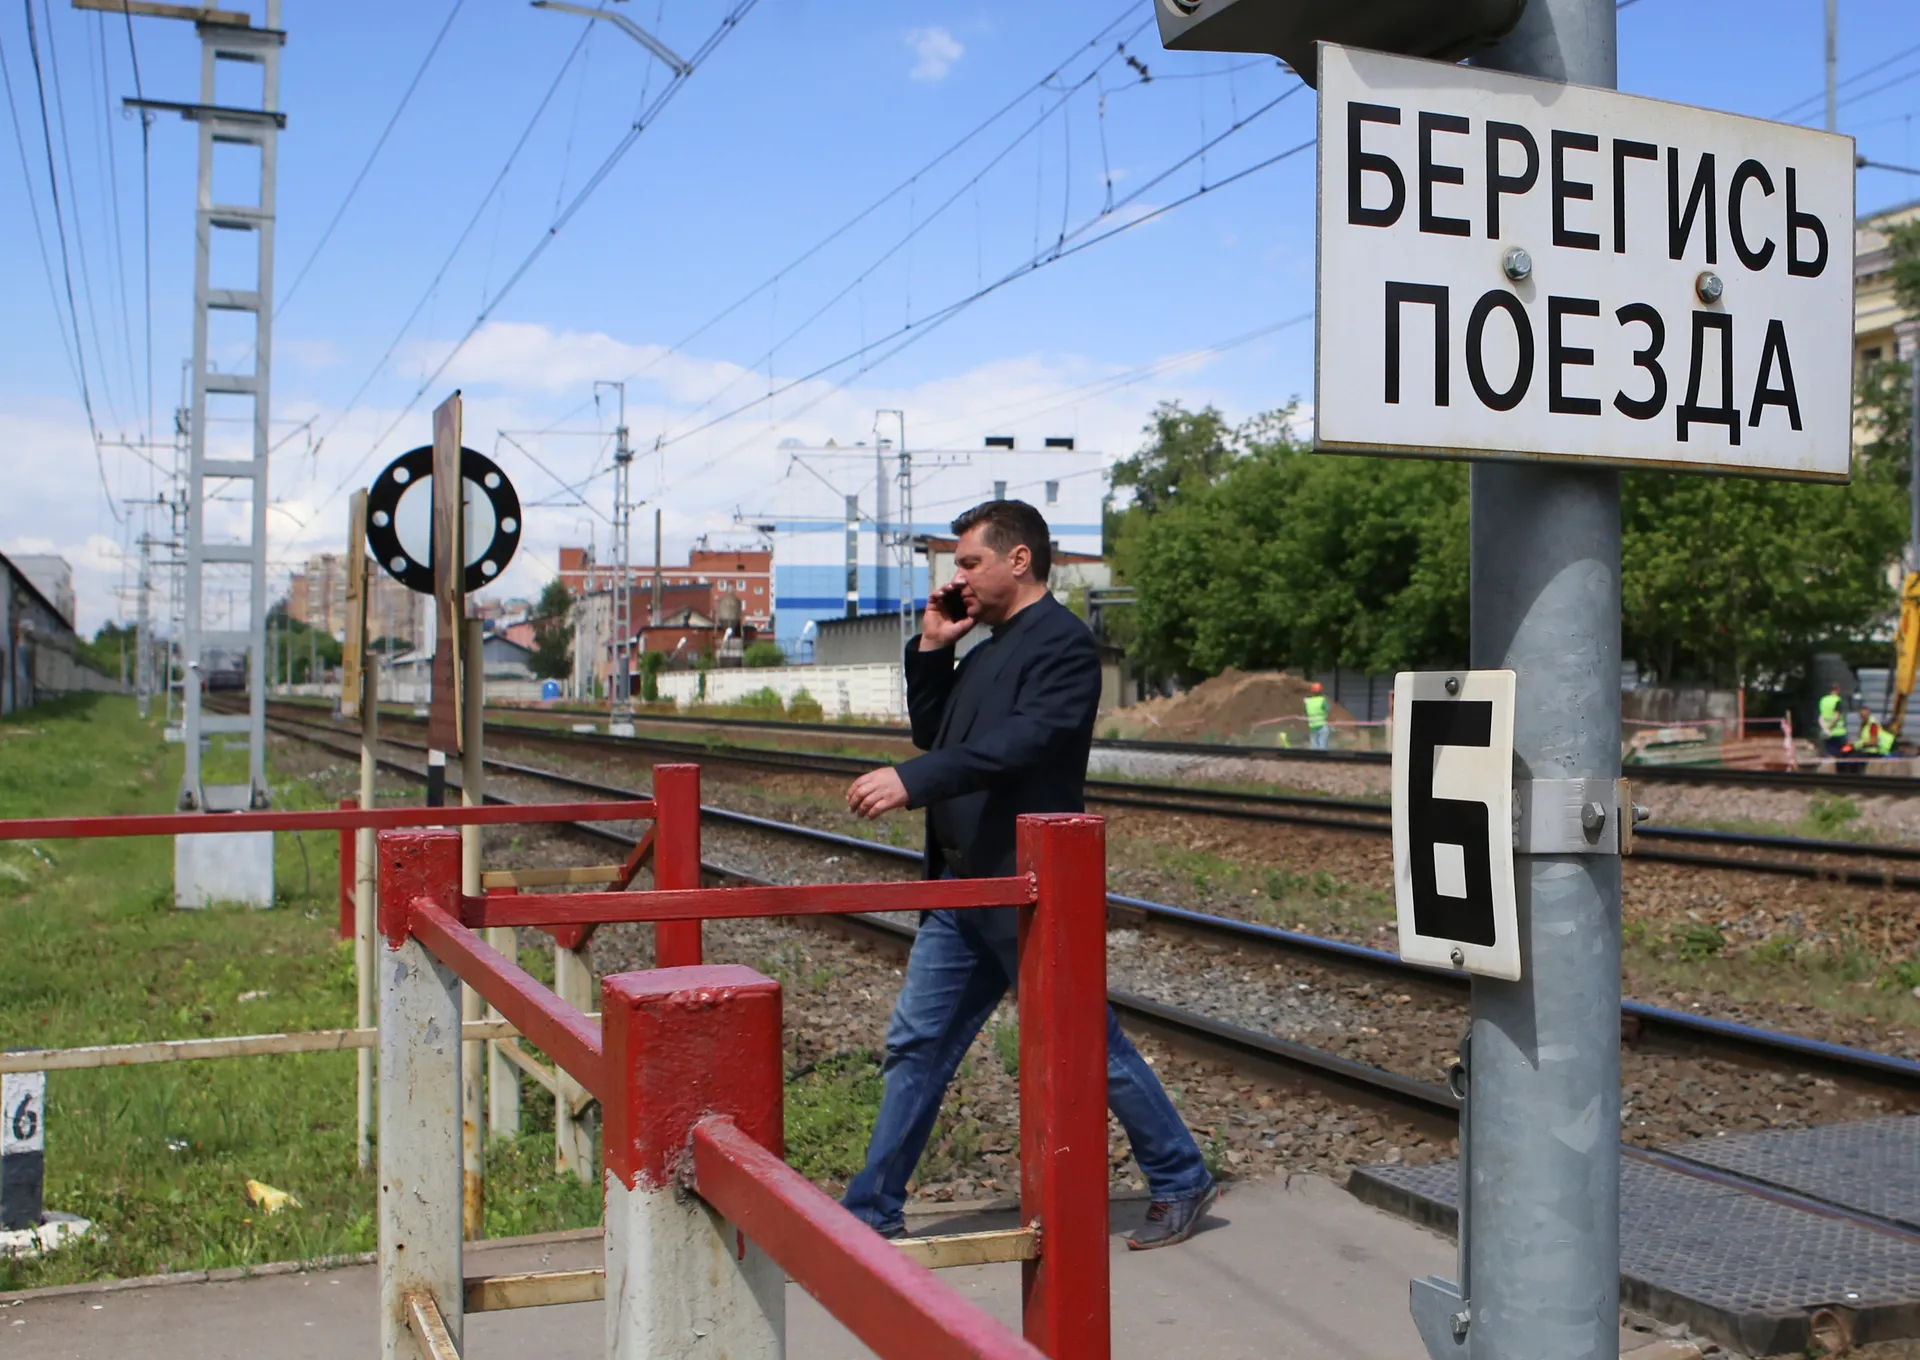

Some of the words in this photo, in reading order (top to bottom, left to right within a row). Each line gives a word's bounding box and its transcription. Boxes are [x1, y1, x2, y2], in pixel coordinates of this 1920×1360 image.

[1347, 101, 1829, 278] БЕРЕГИСЬ
[1384, 280, 1803, 446] ПОЕЗДА
[13, 1093, 37, 1140] 6
